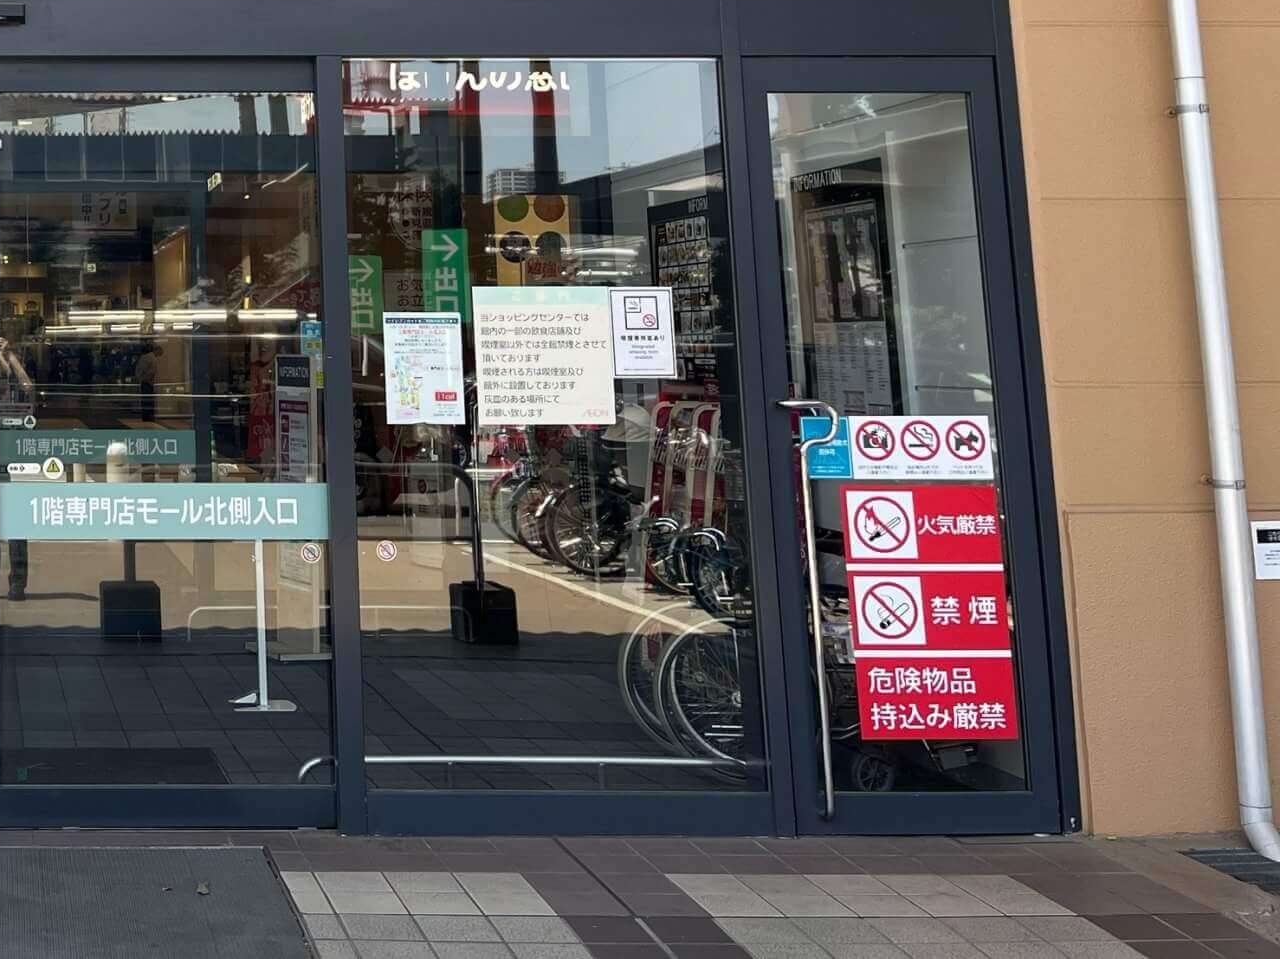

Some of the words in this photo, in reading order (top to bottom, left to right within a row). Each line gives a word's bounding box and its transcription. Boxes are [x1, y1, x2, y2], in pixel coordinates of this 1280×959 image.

[16, 438, 178, 456] 1階専門店モー北側入口
[29, 497, 299, 527] 1階専門店モール北側入口
[917, 515, 996, 536] 火気厳禁
[930, 595, 999, 626] 禁煙
[867, 666, 977, 694] 危険物品
[870, 702, 1007, 730] 持込み厳禁
